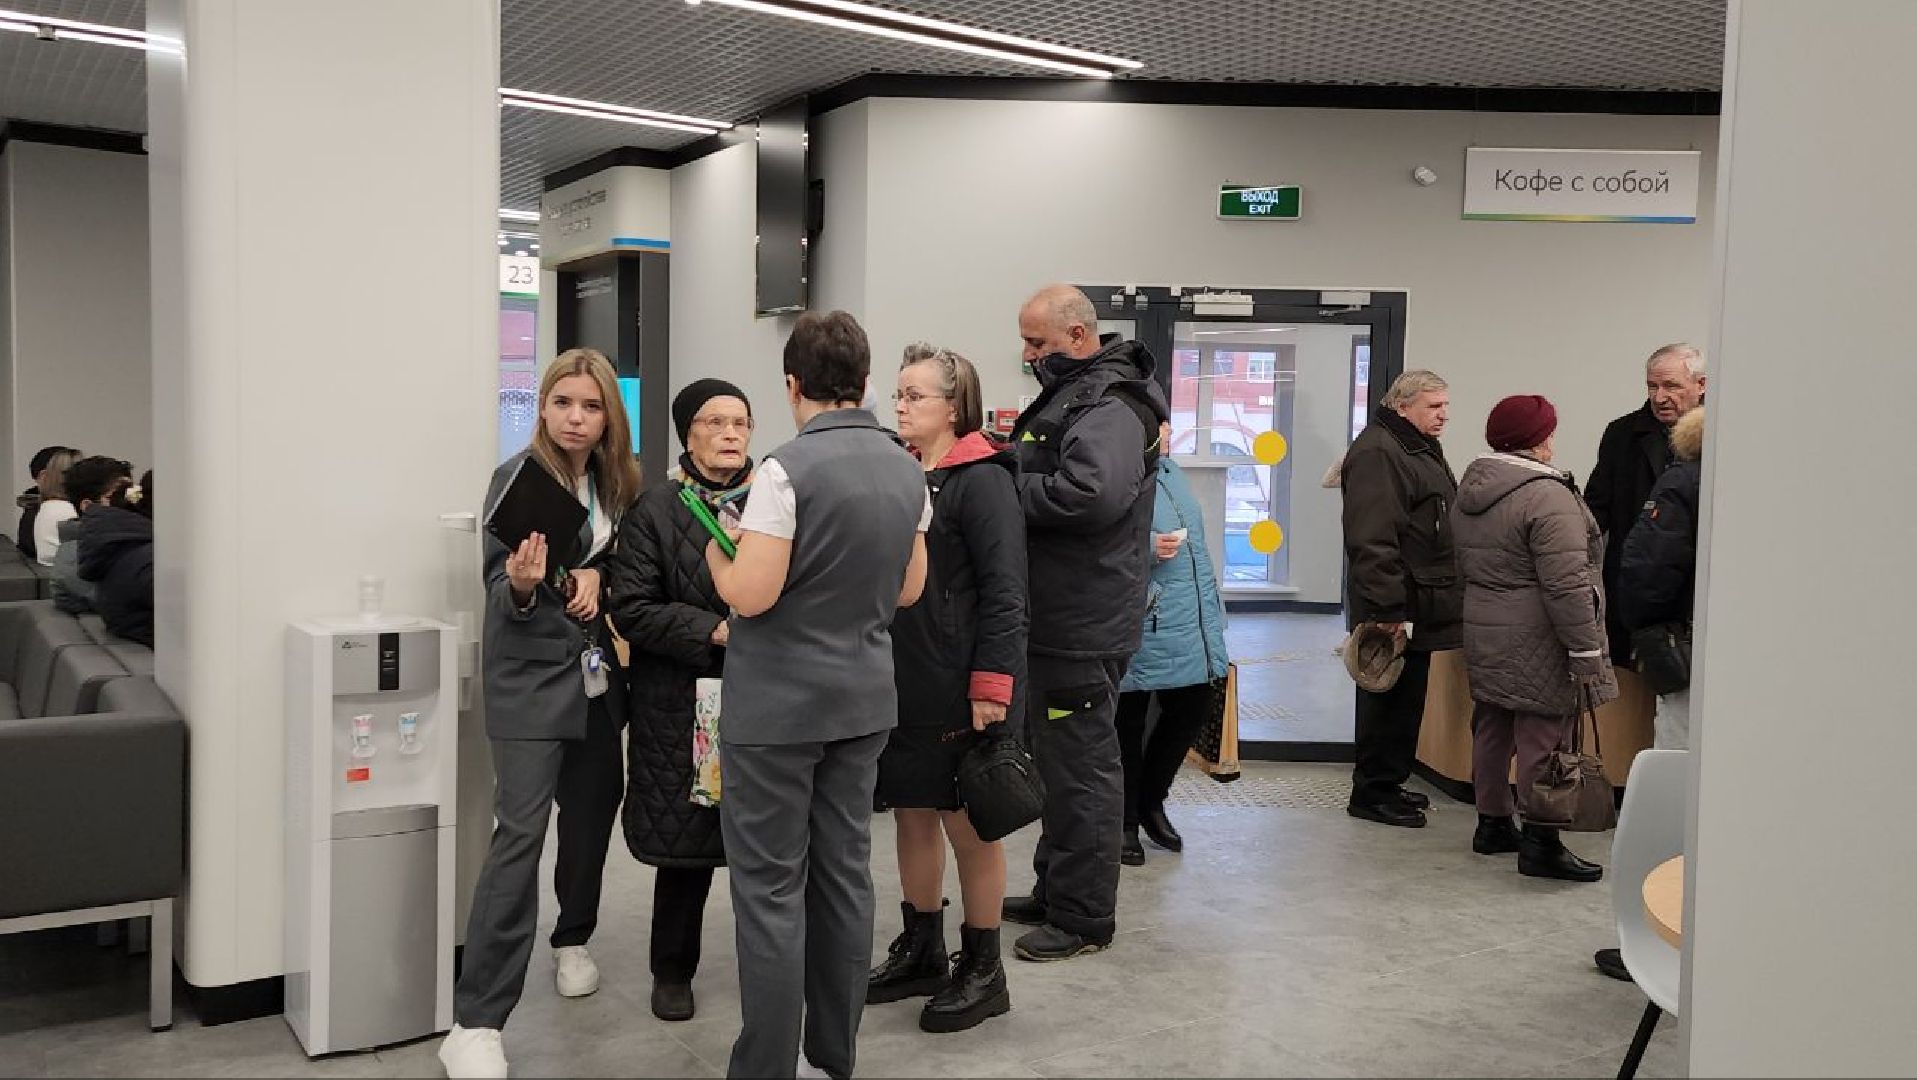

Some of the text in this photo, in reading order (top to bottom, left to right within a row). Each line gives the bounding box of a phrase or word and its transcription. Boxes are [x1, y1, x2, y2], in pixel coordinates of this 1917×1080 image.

[1495, 169, 1669, 196] Кофе с собой
[1240, 190, 1279, 204] ВЫХОД
[1248, 204, 1272, 214] EXIT
[508, 265, 534, 284] 23
